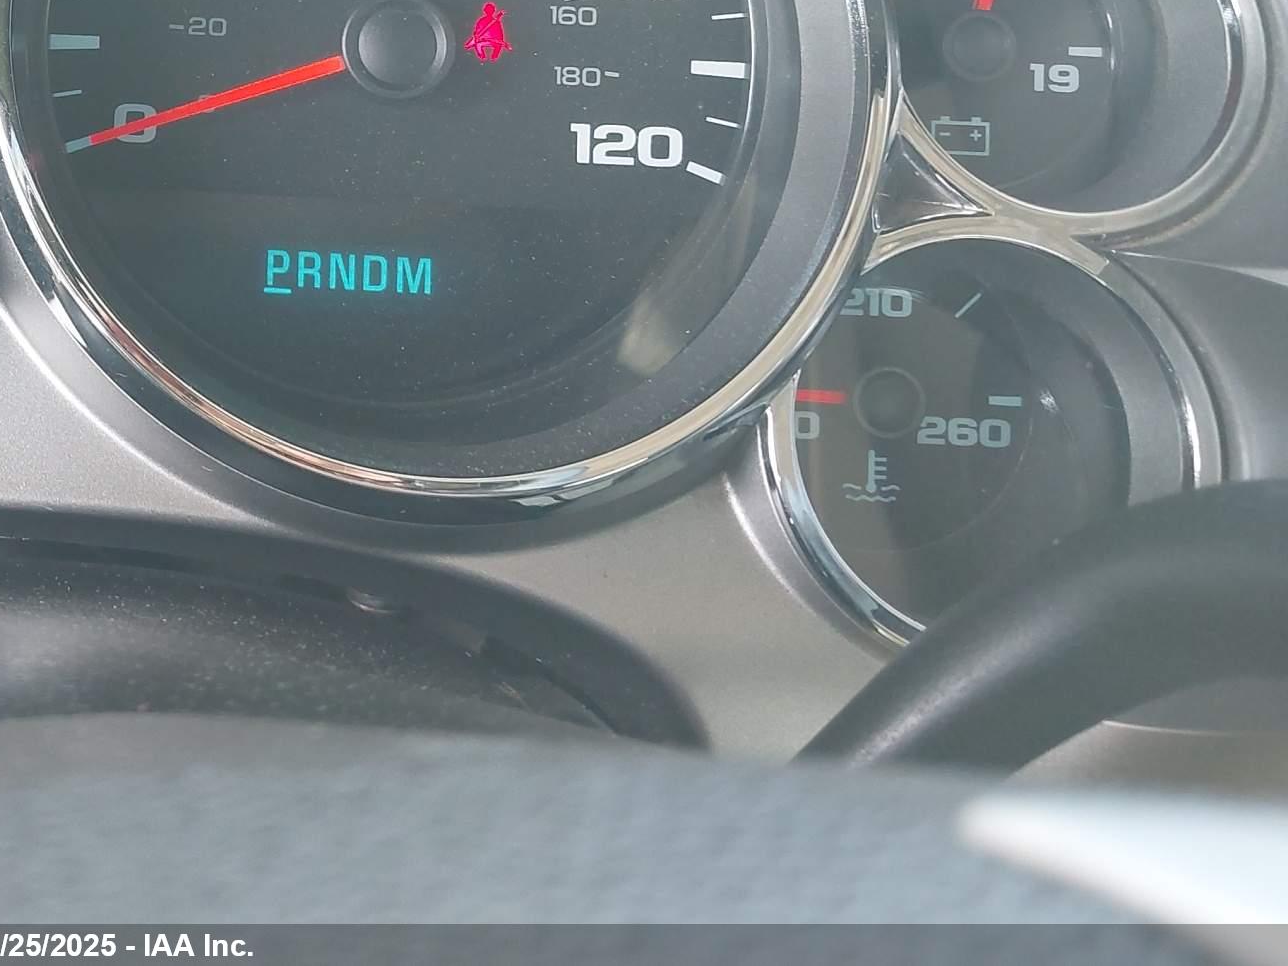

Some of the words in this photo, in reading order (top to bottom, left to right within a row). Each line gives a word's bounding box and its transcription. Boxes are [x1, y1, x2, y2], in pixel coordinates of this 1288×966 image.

[189, 17, 227, 36] 20
[550, 6, 596, 25] 160
[554, 67, 601, 86] 180
[1030, 63, 1079, 92] 19
[114, 103, 158, 144] 0
[571, 123, 683, 167] 120
[839, 288, 912, 317] 210
[918, 417, 1010, 447] 260
